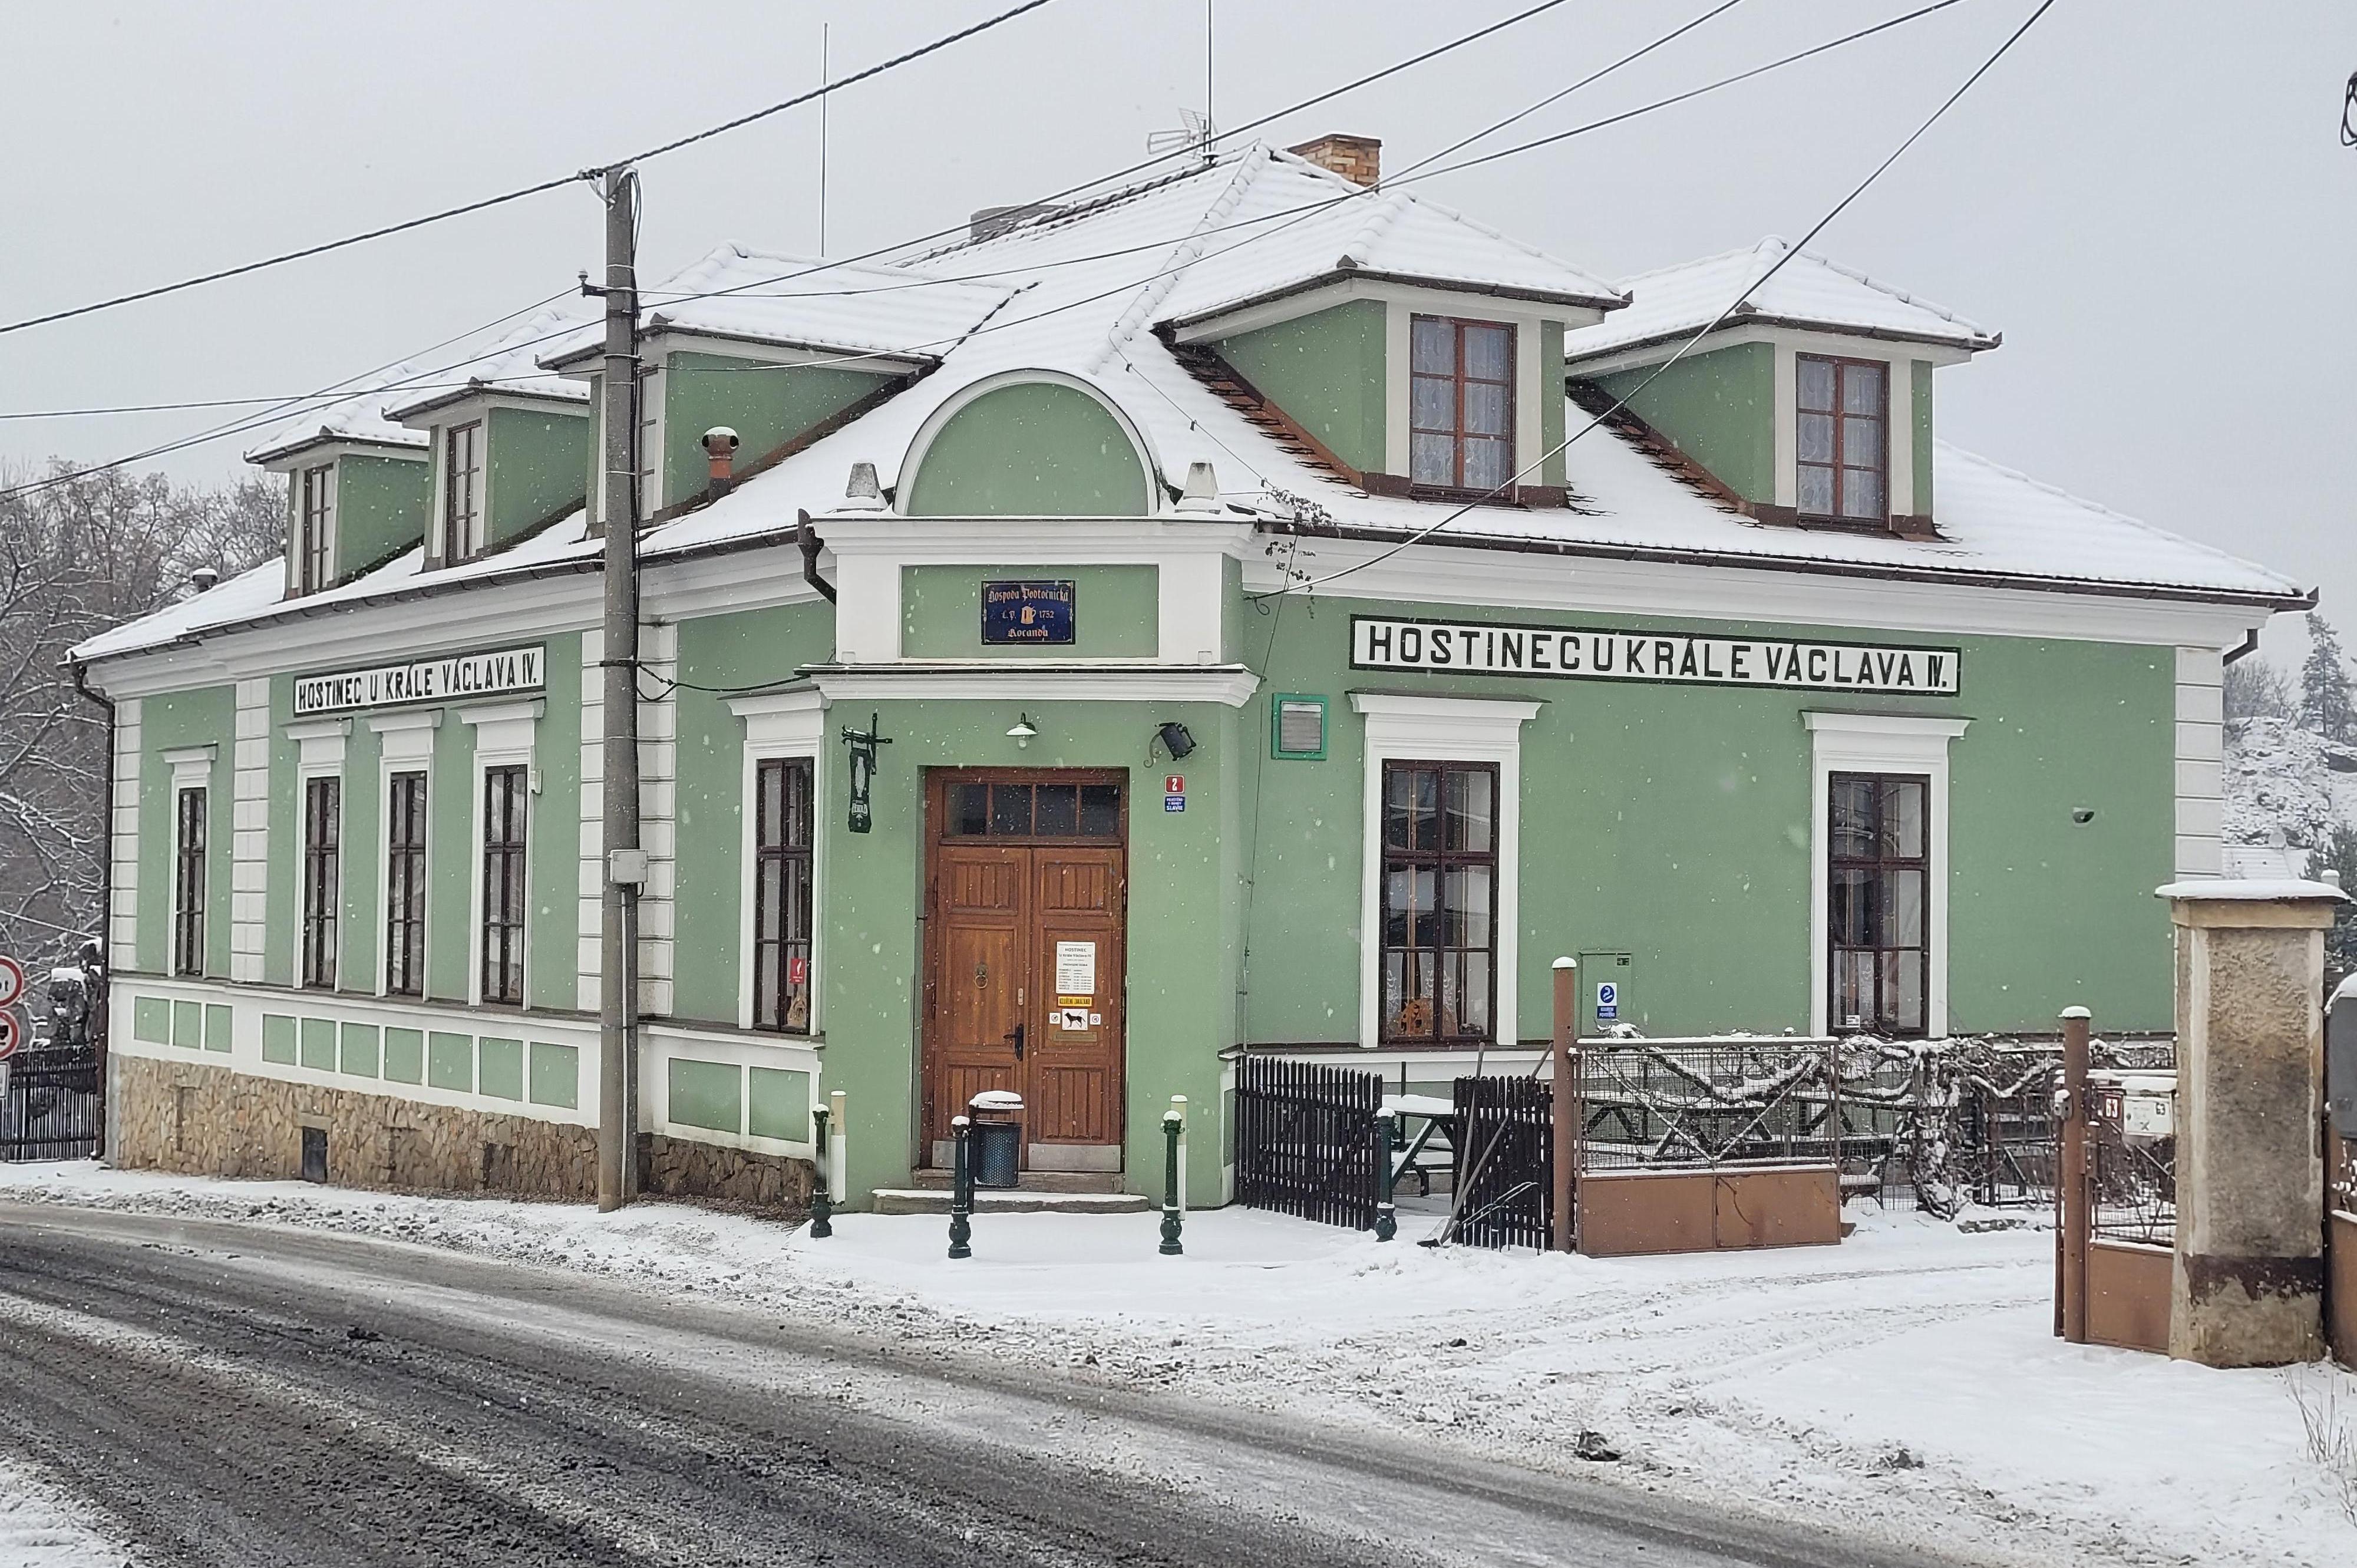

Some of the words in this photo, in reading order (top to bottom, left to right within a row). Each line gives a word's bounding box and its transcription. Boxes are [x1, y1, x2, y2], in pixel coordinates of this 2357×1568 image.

[1039, 610, 1055, 619] 1752
[1368, 625, 1581, 670] HOSTINEC
[1593, 637, 1613, 671] U
[1626, 638, 1751, 679] KRÁLE
[1765, 643, 1914, 686] VÁCLAVA
[1927, 655, 1947, 688] IV.
[299, 676, 362, 710] HOSTINEC
[370, 675, 378, 702] U
[386, 663, 433, 700] KRÁLE
[443, 656, 516, 694] VÁCLAVA
[522, 652, 537, 684] IV.
[1172, 778, 1177, 791] 2
[2106, 1098, 2118, 1118] 63
